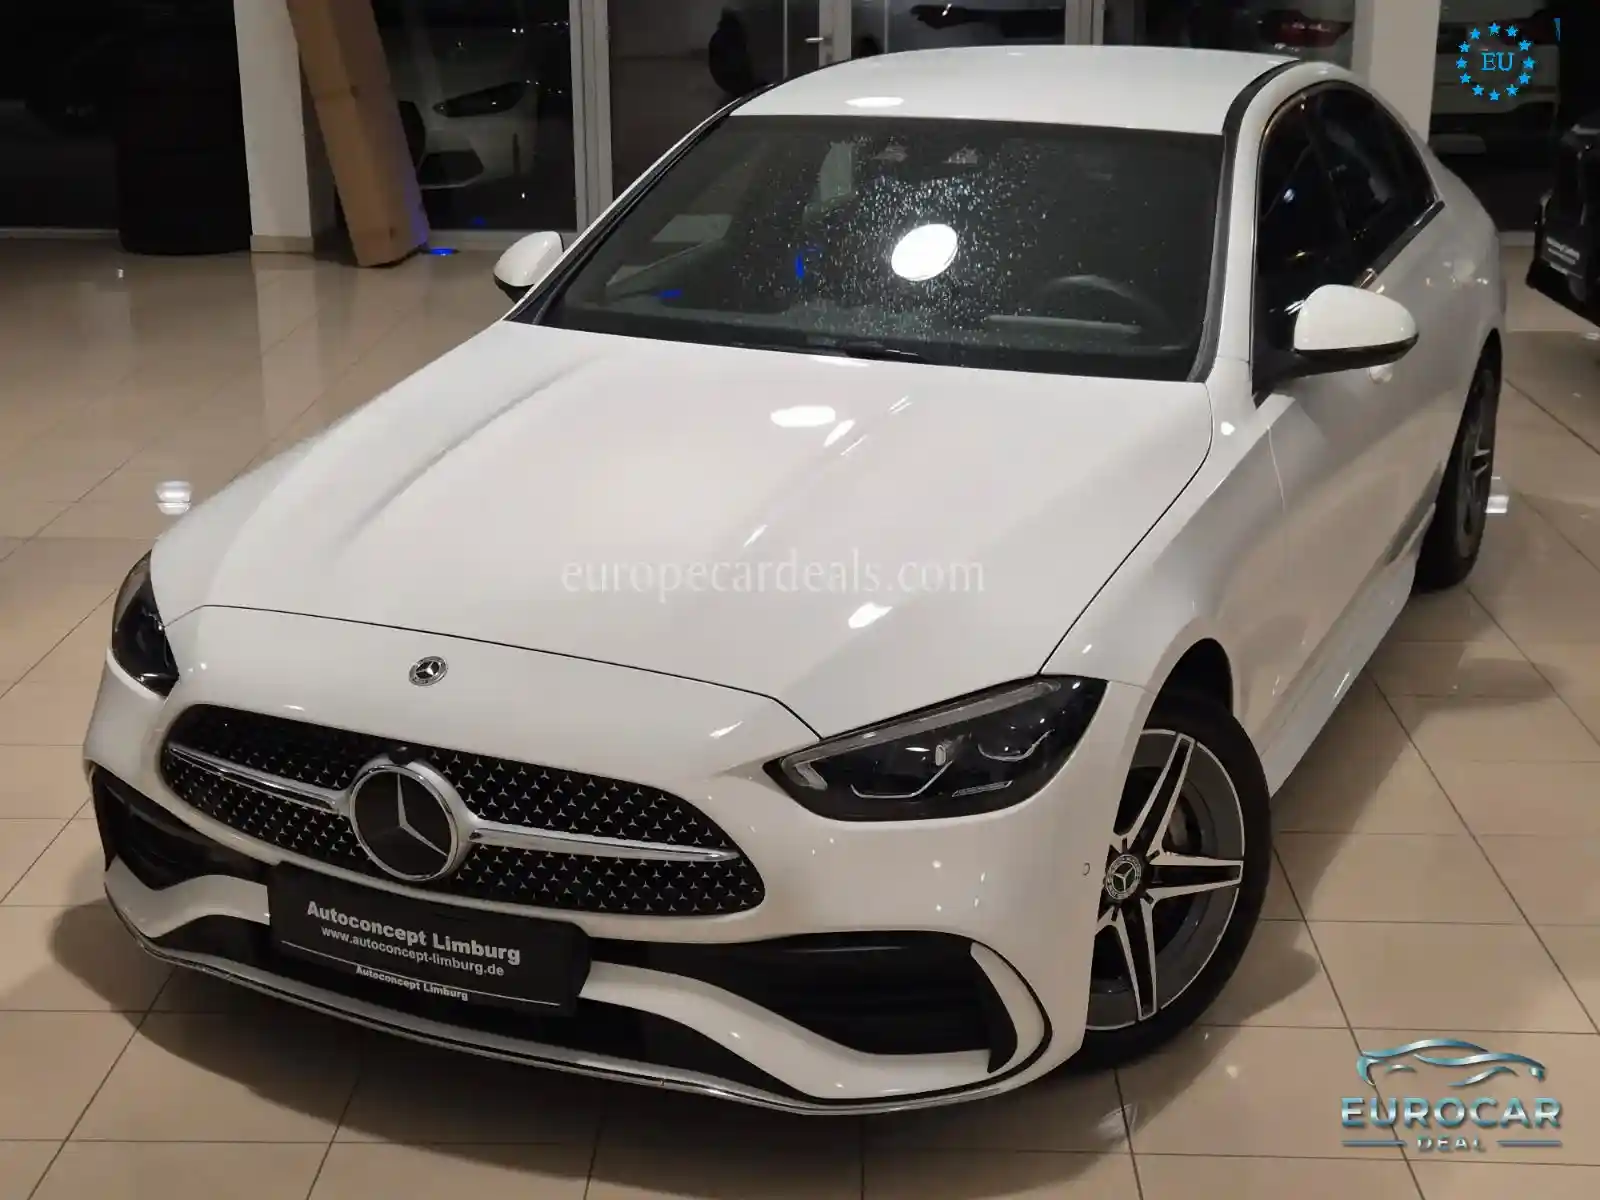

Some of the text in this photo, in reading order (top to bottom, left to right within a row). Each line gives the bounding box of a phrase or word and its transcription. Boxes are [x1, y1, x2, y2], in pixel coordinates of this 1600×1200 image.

[307, 900, 521, 966] Autoconcept Limburg
[321, 926, 505, 976] www.autoconcept-limburg.de
[355, 965, 469, 1001] Autoconcept Limburg
